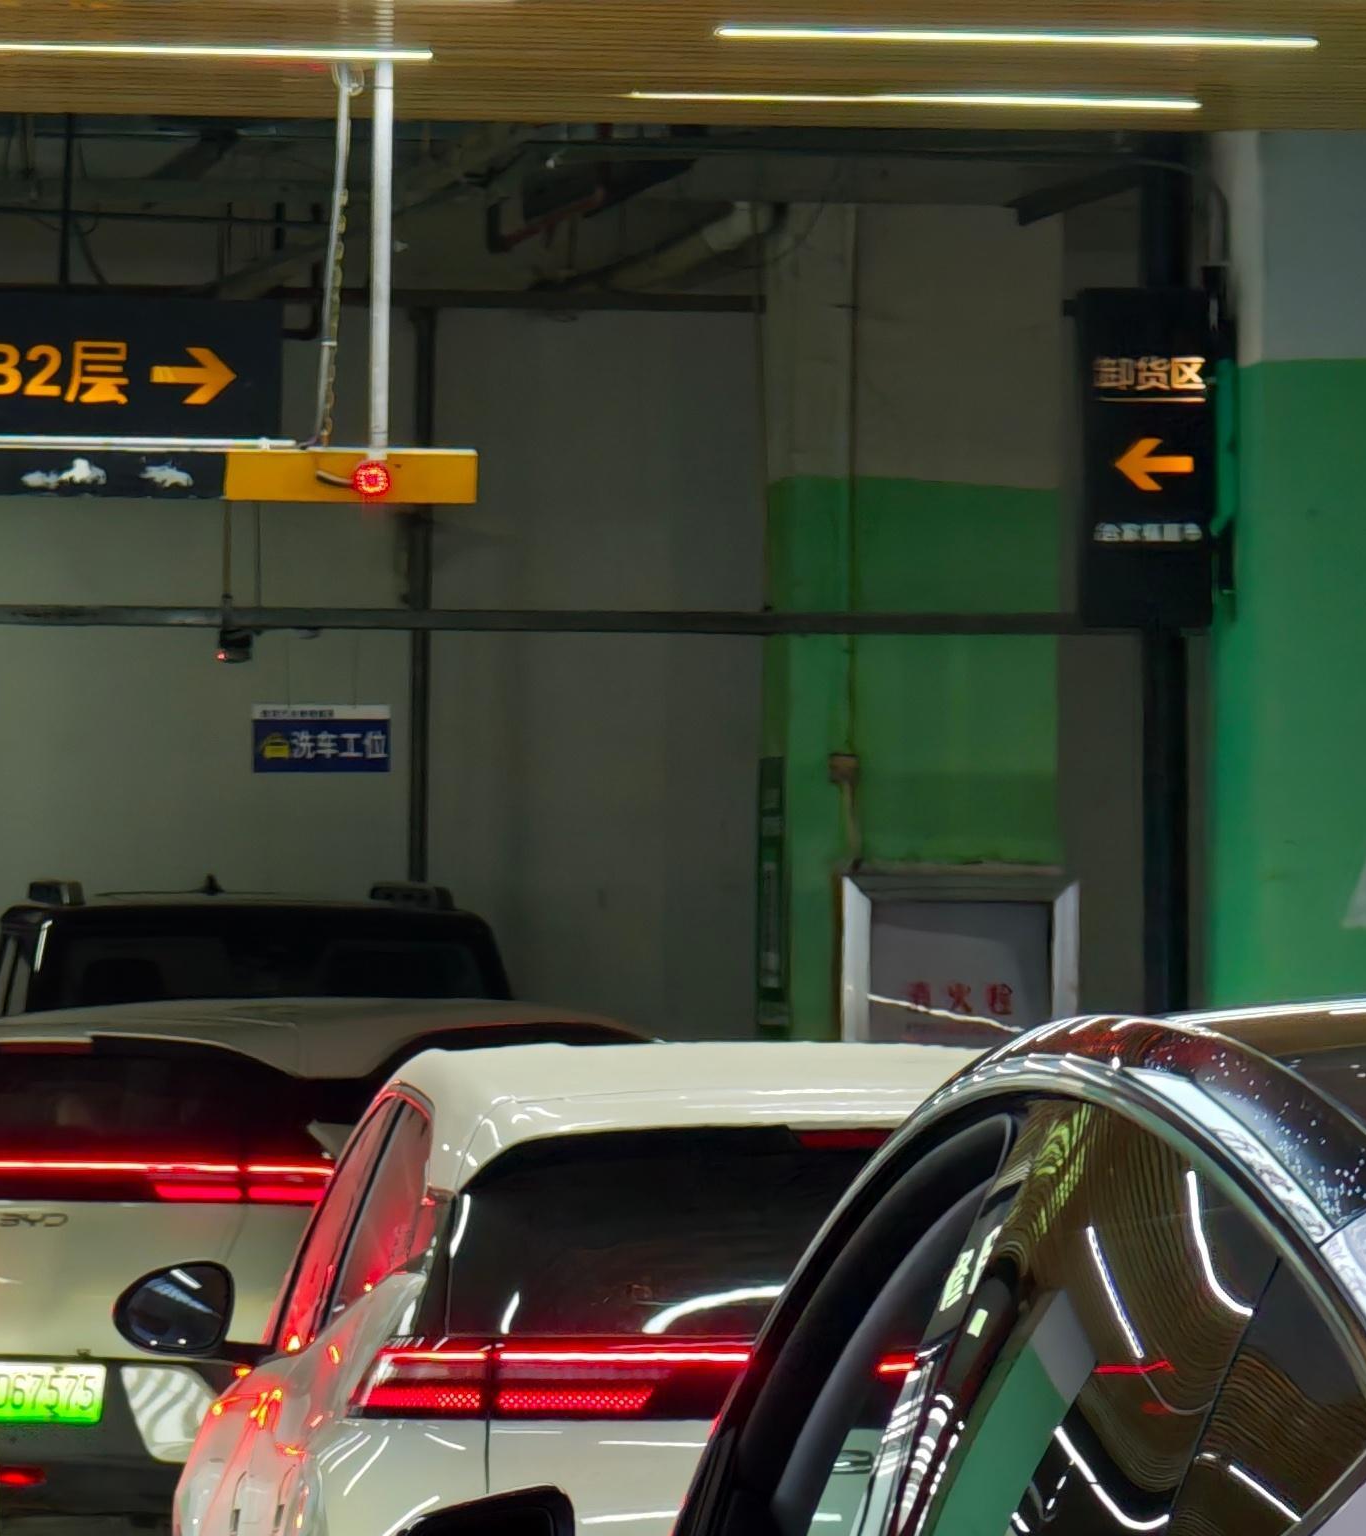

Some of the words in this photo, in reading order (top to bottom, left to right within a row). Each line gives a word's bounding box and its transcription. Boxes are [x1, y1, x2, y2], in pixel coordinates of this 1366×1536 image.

[1092, 355, 1206, 391] 卸货区
[291, 731, 388, 759] 洗车工位
